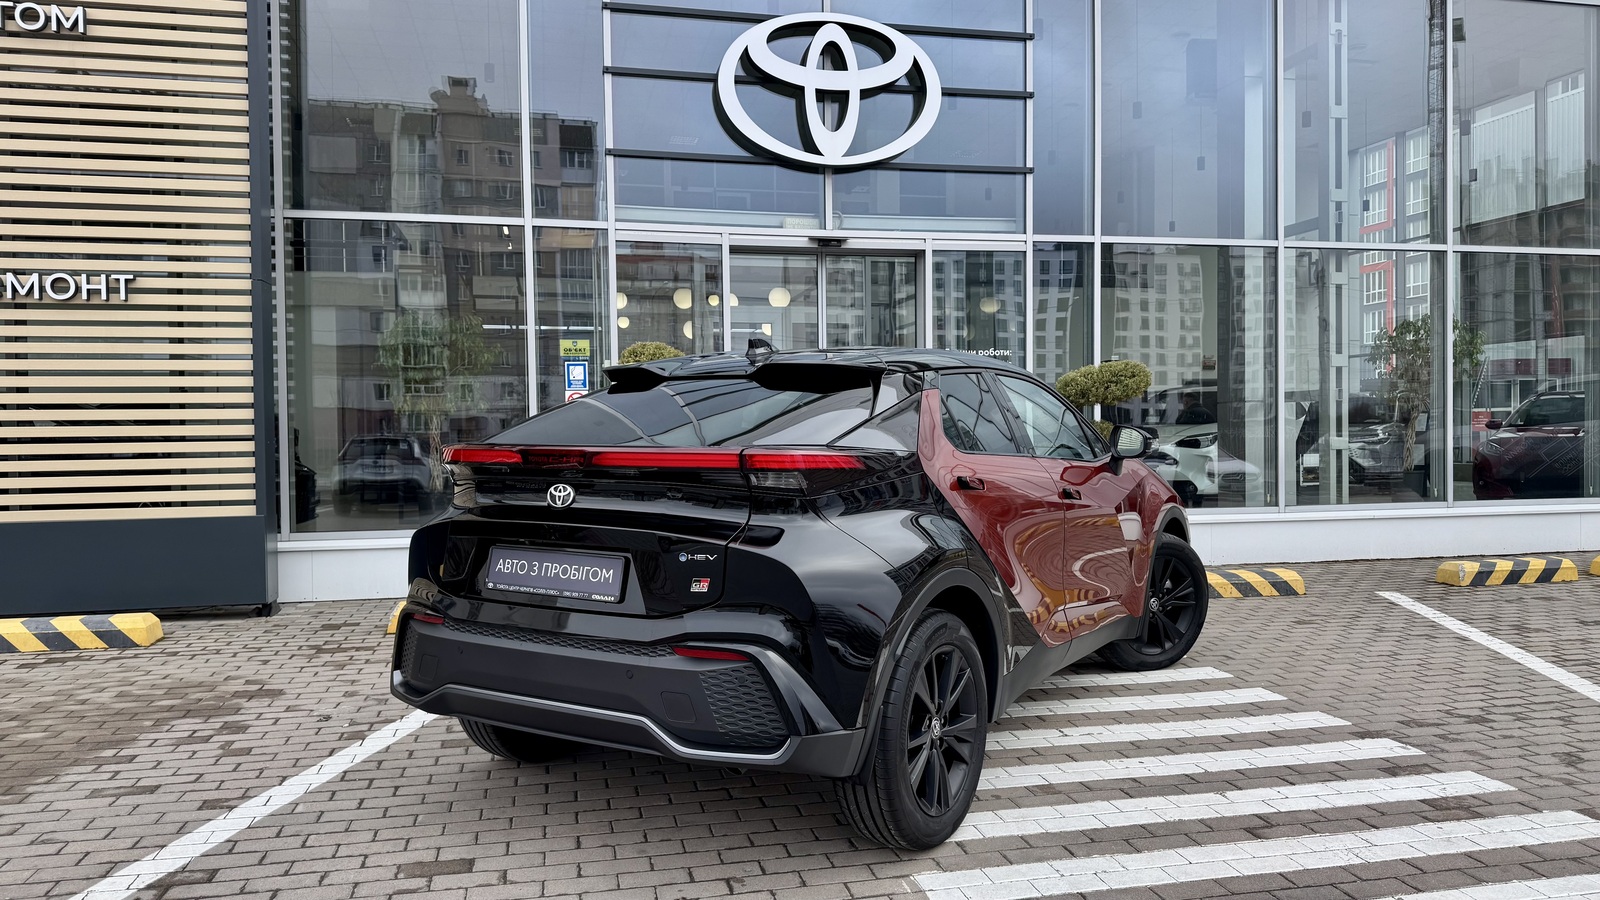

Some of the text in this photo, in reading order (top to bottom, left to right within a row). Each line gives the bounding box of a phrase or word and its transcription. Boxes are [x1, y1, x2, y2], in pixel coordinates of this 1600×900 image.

[0, 272, 135, 301] МОНТ
[495, 558, 614, 583] АВТО З ПРОБІГОМ
